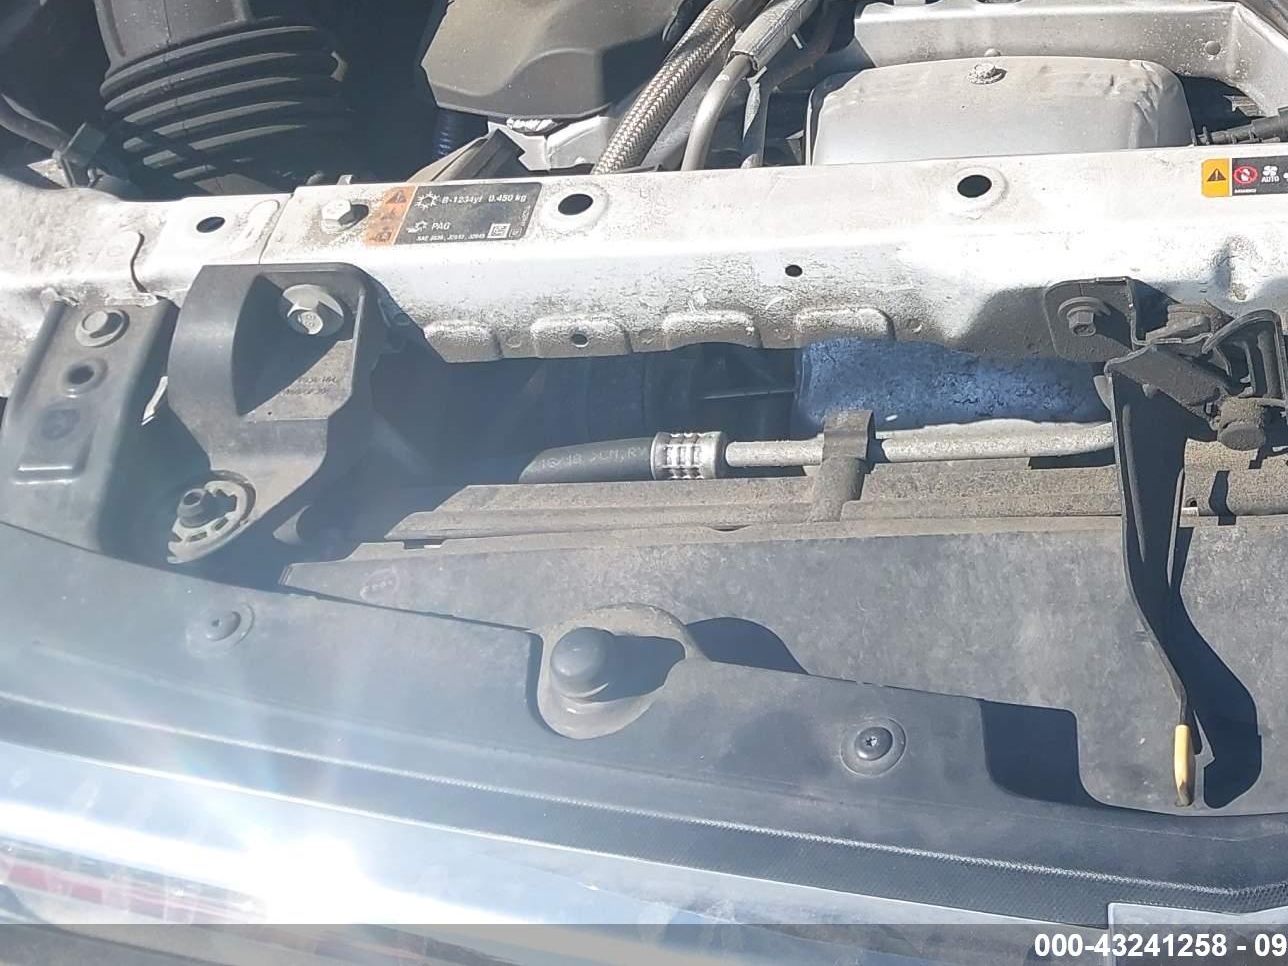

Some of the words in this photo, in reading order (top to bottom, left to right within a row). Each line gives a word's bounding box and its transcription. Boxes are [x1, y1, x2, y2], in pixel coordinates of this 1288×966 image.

[1261, 175, 1280, 183] AUTO
[488, 194, 513, 203] 0.450
[514, 193, 527, 203] kg
